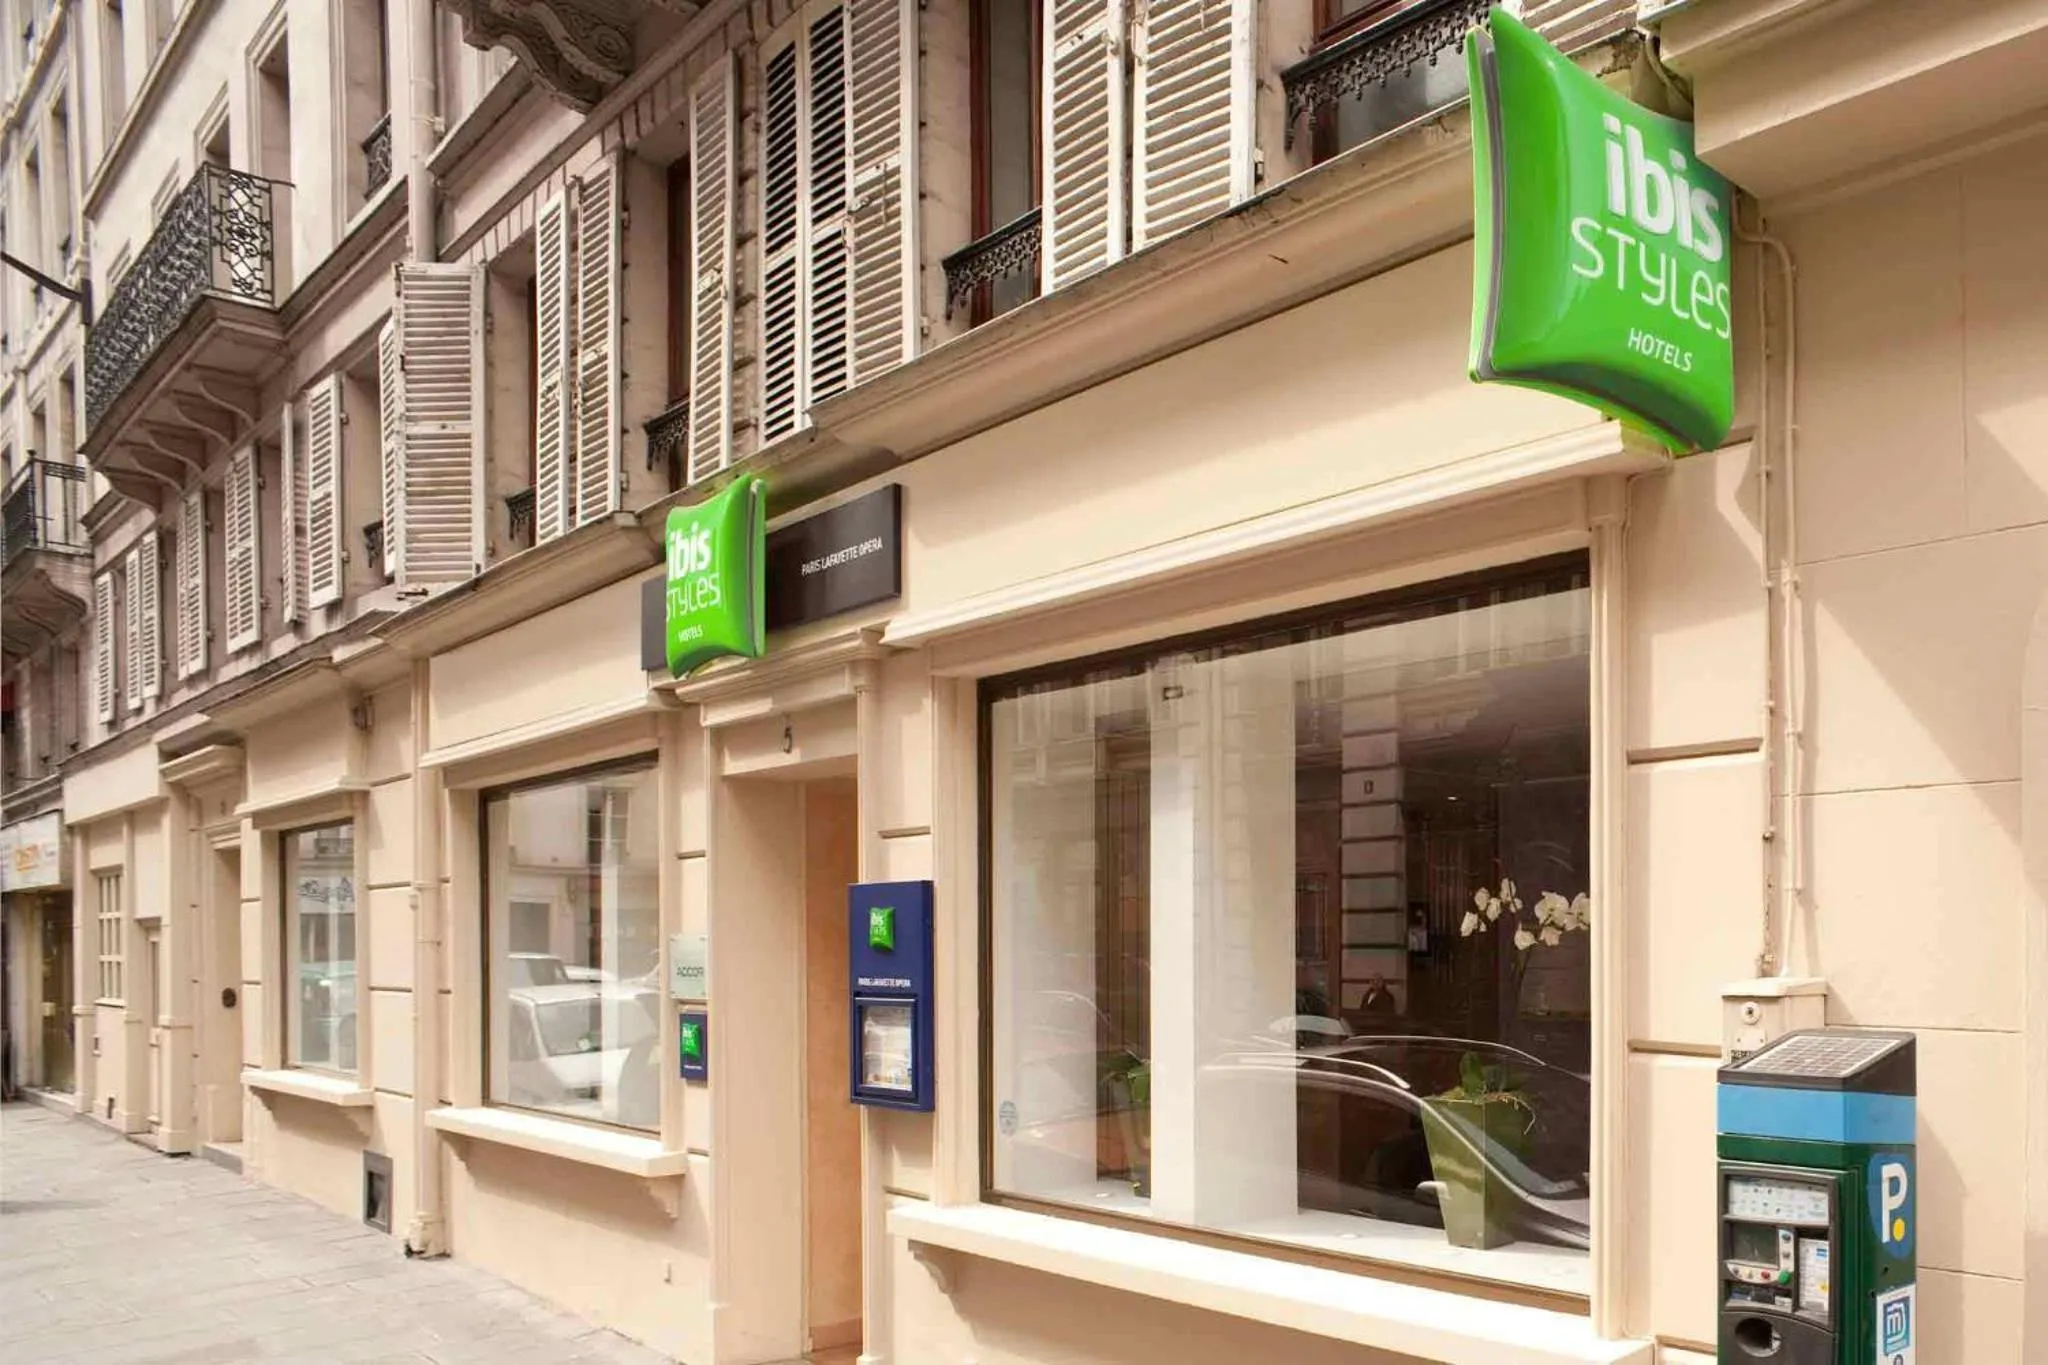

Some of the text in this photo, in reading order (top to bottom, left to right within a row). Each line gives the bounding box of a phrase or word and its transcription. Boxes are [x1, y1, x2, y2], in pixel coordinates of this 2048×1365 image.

[1603, 112, 1723, 262] ibis
[1627, 327, 1693, 372] HOTELS
[667, 520, 713, 581] ibis
[858, 535, 883, 556] OPERA
[783, 726, 793, 755] 5
[1881, 1162, 1908, 1244] P
